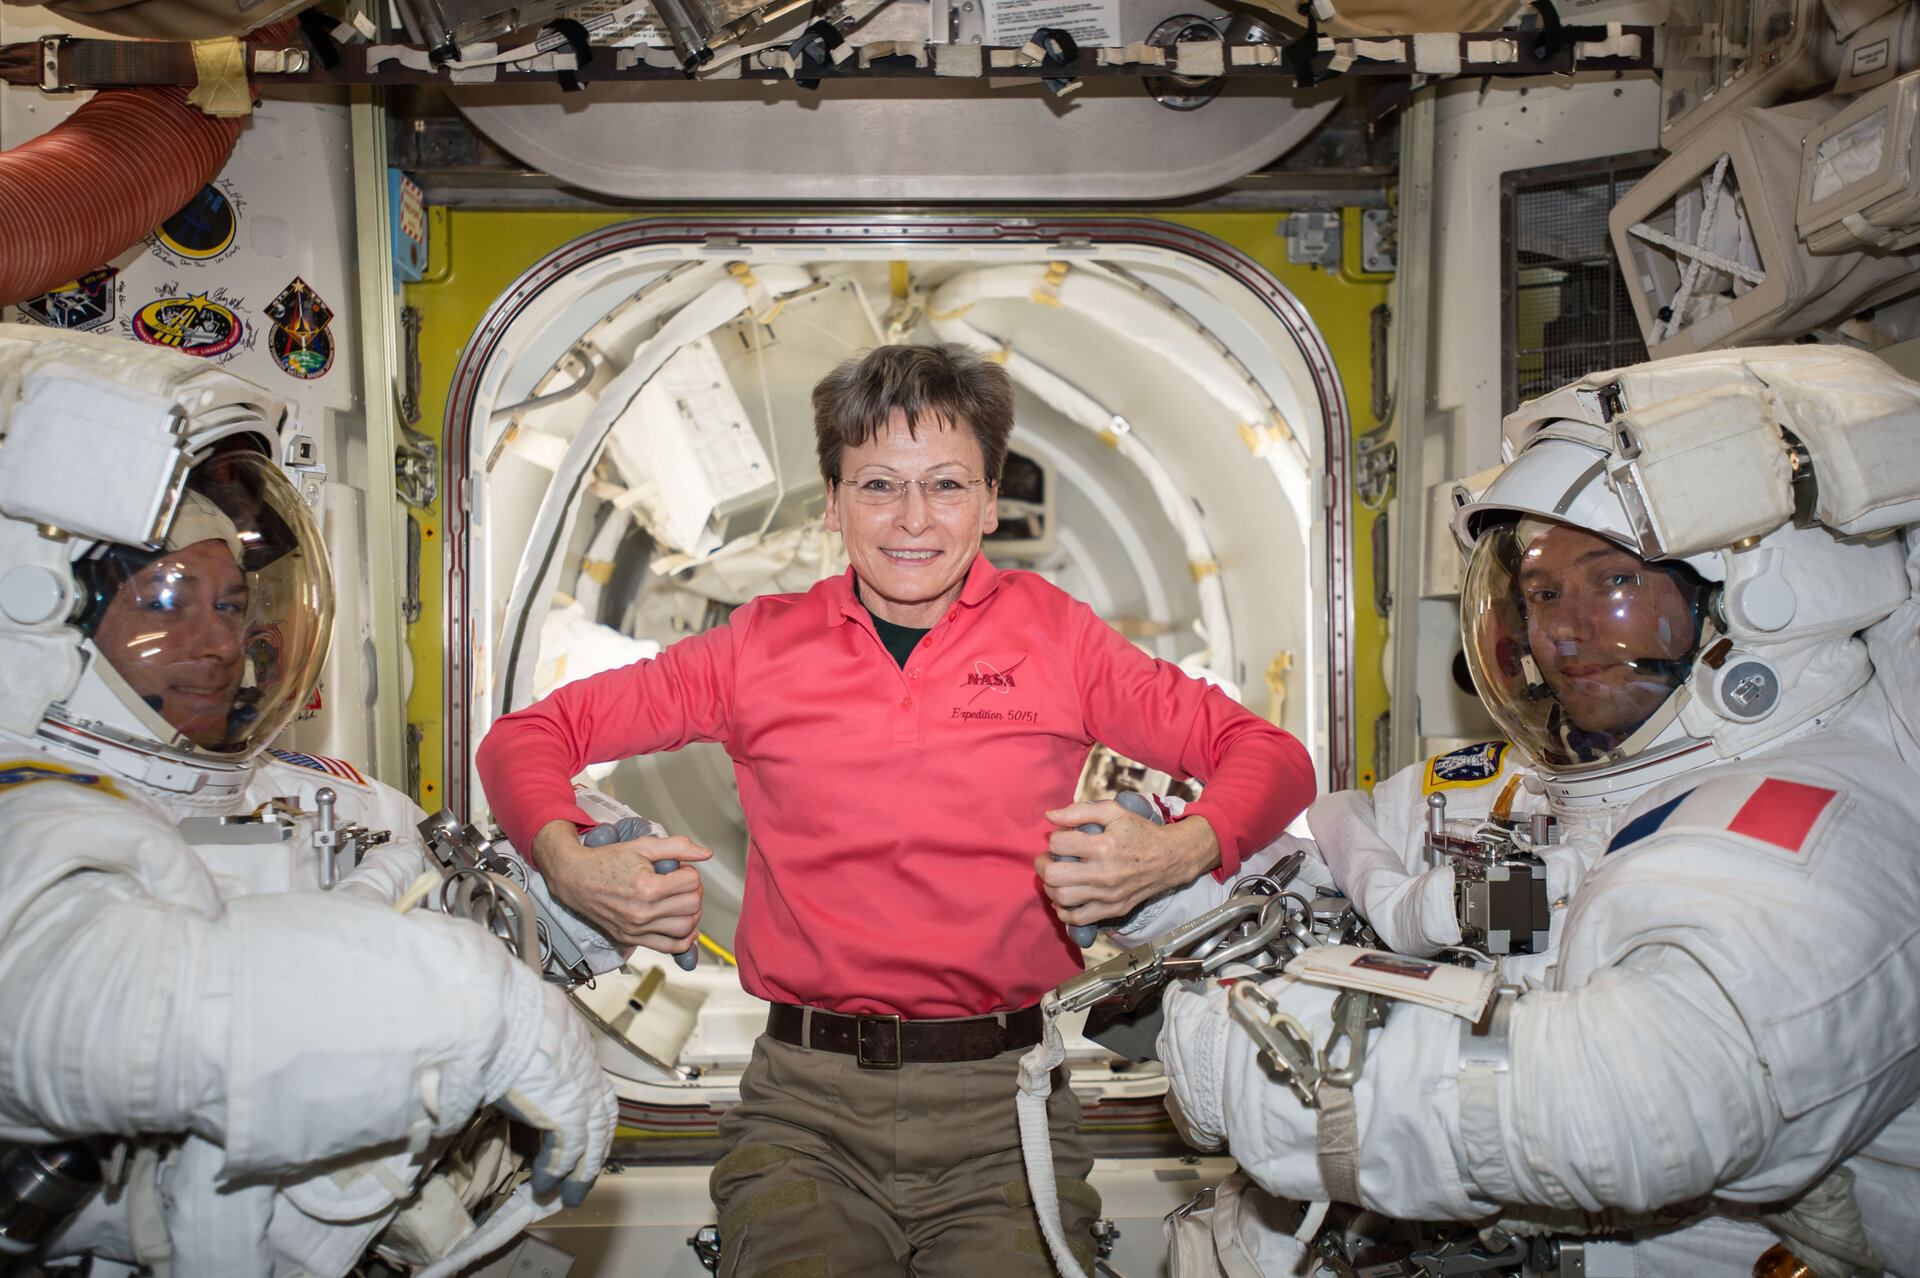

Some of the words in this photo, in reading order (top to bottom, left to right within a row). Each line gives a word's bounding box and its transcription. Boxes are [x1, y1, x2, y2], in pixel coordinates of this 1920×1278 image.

[74, 317, 103, 331] PATRICK
[967, 672, 1016, 687] NASA
[951, 707, 1004, 722] Expedition
[1007, 709, 1038, 723] 50/51
